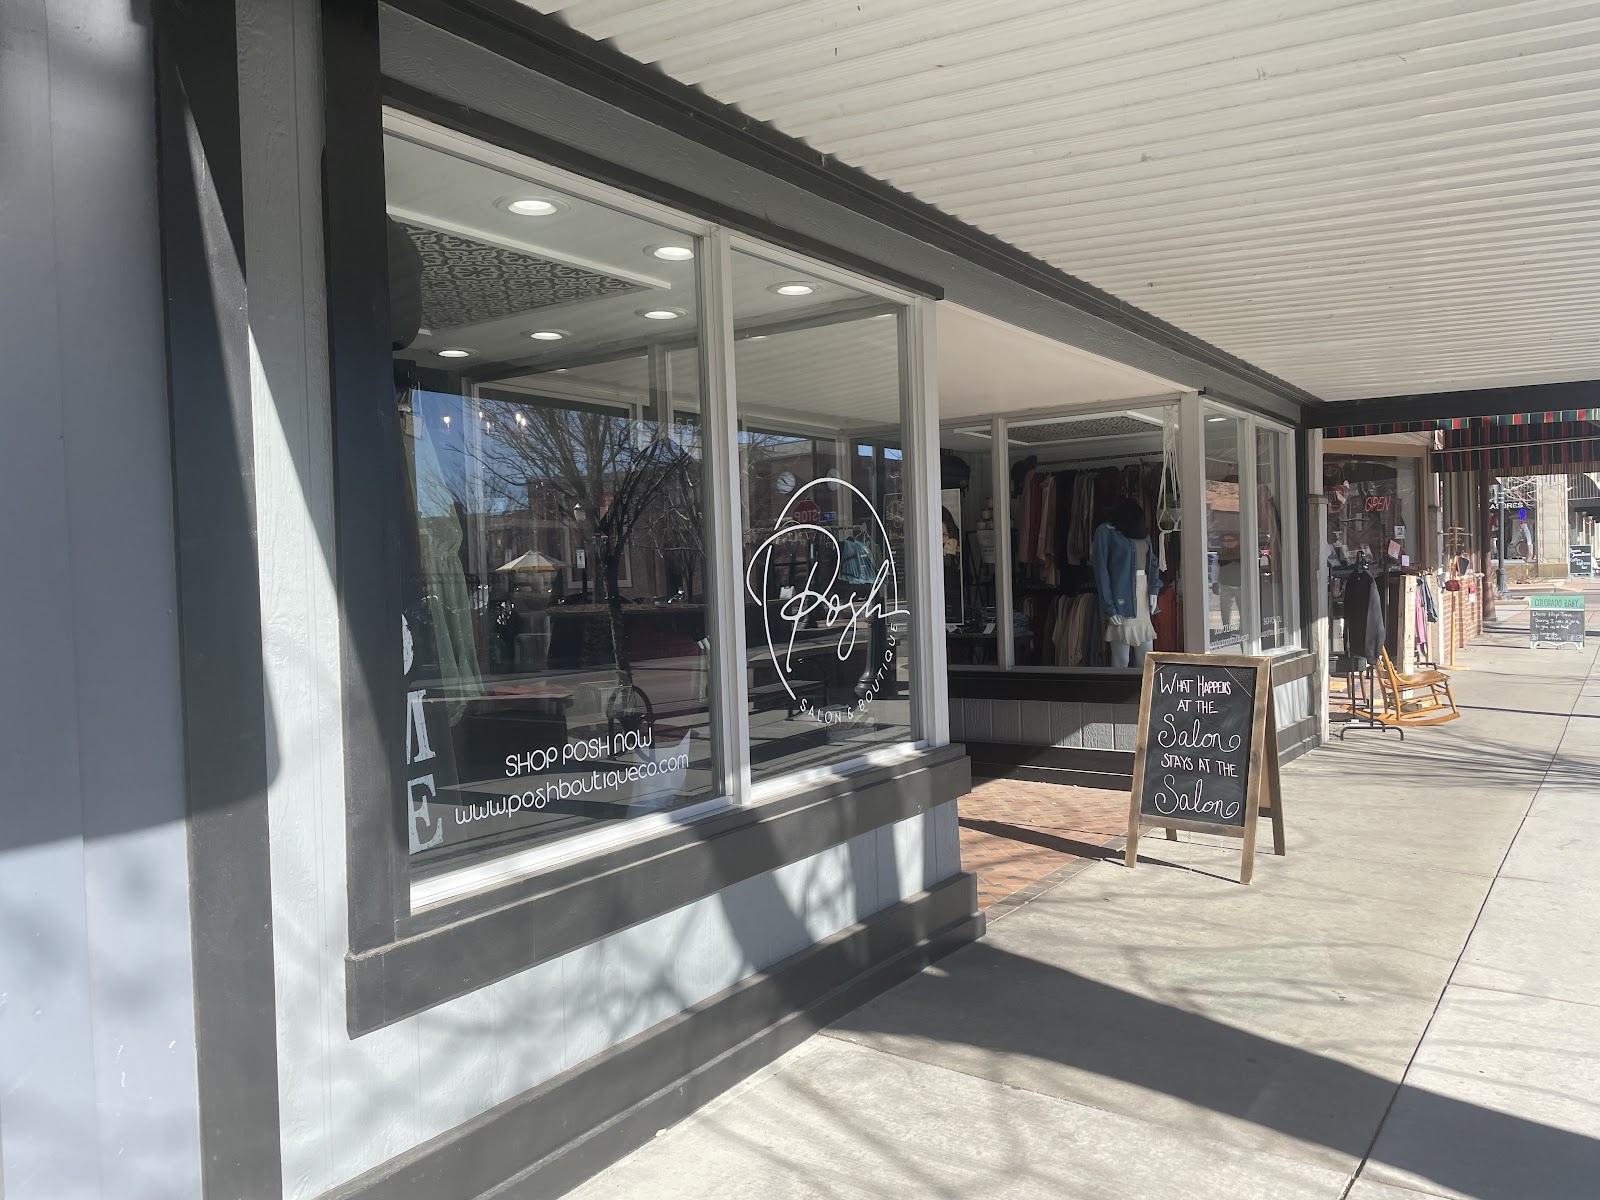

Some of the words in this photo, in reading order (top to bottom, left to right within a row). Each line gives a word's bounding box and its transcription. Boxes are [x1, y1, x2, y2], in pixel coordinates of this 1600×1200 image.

[1365, 496, 1391, 512] OPEN
[746, 524, 911, 673] Posh
[1534, 598, 1562, 607] COLORADO
[1564, 599, 1579, 607] BABY
[799, 698, 842, 724] SALON
[858, 622, 899, 711] BOUTIQUE
[1177, 699, 1192, 712] AT
[1195, 700, 1218, 714] THE
[505, 746, 558, 778] SHOP
[562, 735, 610, 767] POSH
[613, 726, 652, 755] NOW
[1158, 713, 1241, 753] Salon
[1160, 753, 1194, 771] STAYS
[1198, 757, 1211, 772] AT
[1216, 760, 1238, 778] THE
[454, 752, 689, 825] www.poshboutiqueco.com
[1154, 774, 1240, 819] Salon
